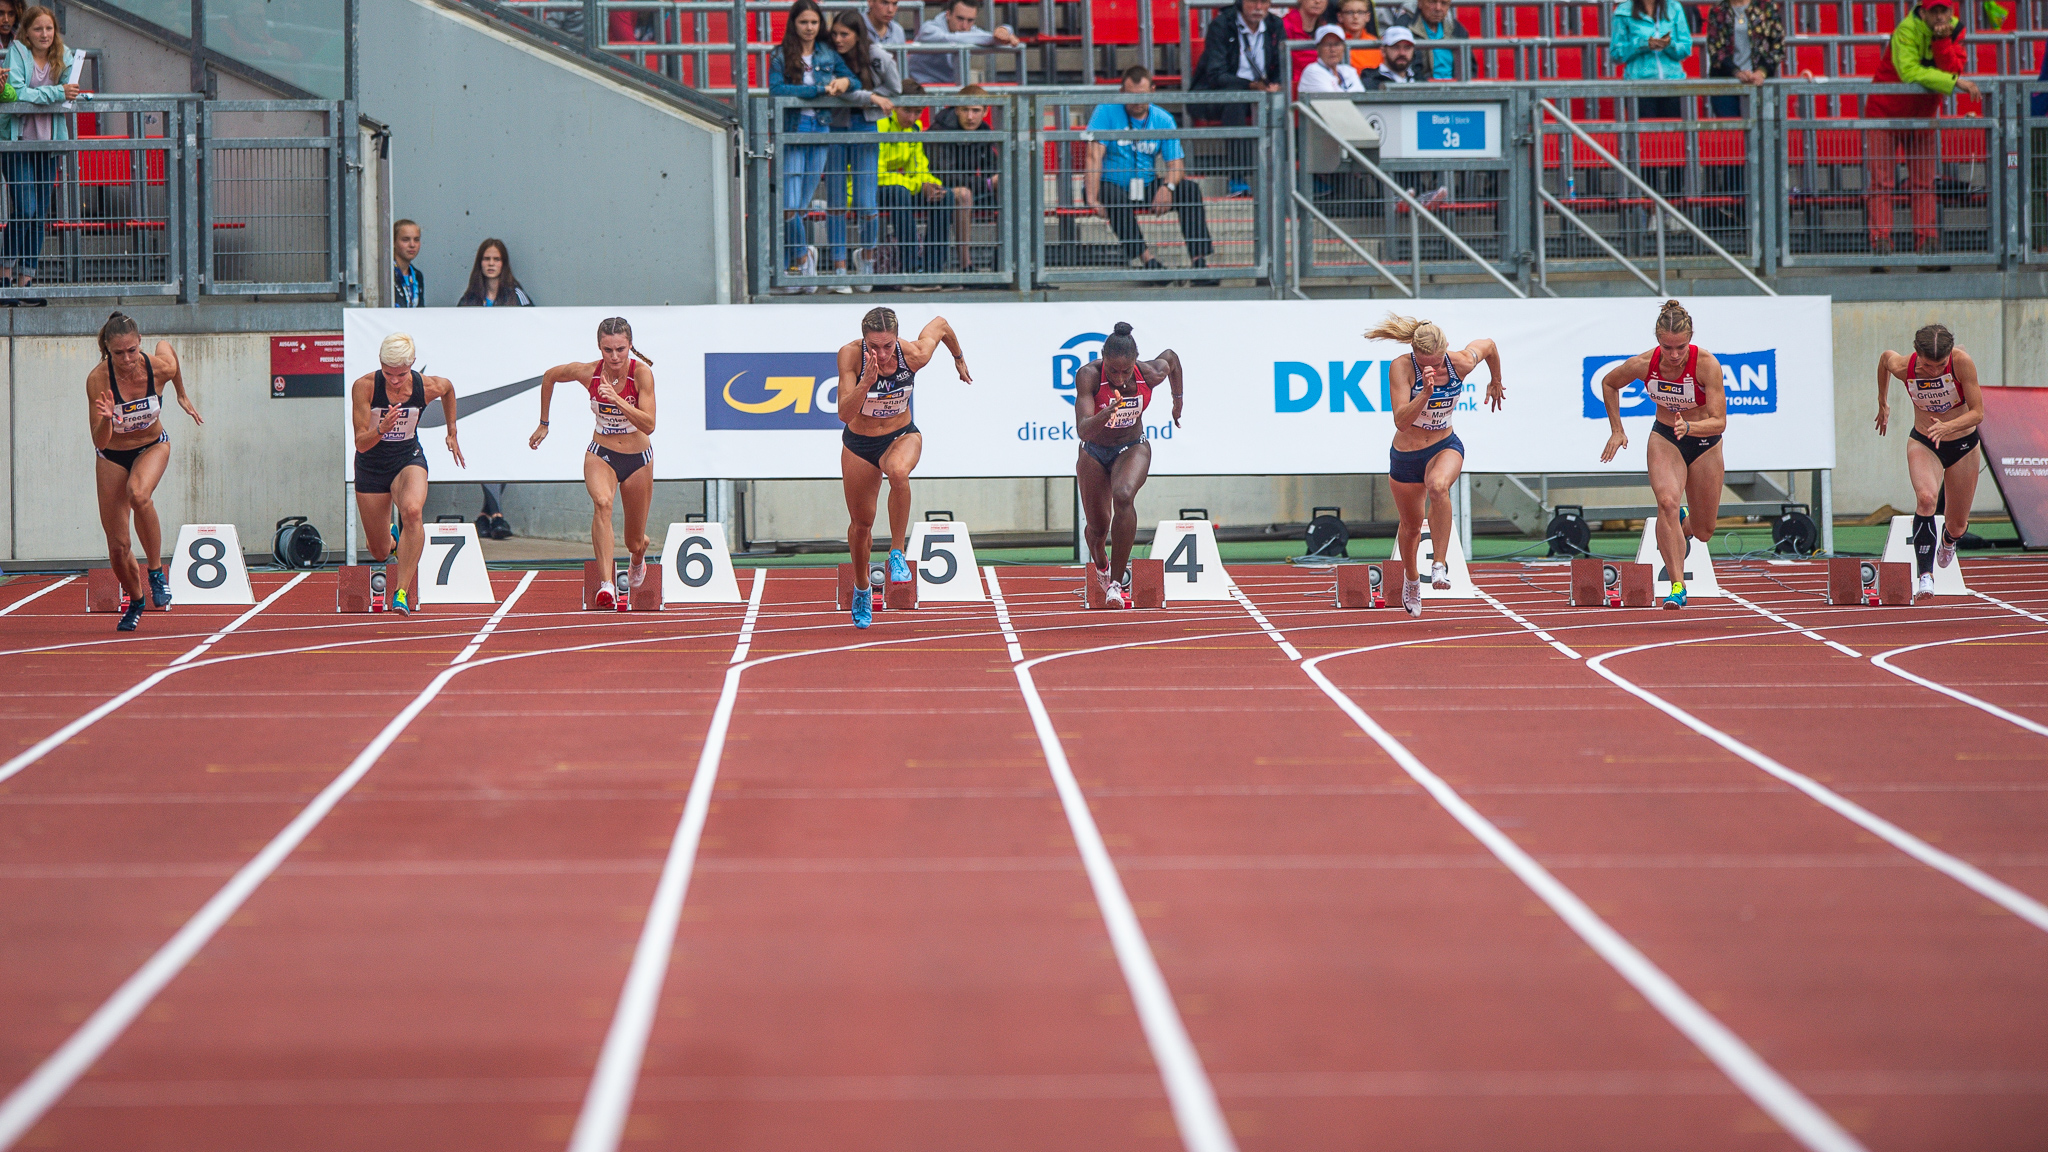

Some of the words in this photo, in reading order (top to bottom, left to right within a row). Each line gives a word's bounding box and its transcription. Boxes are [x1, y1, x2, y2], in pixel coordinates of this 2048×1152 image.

[1442, 127, 1460, 147] 3a
[1650, 392, 1693, 404] Bechthold
[1916, 389, 1950, 400] Grünert
[136, 401, 148, 410] GLS
[1126, 400, 1137, 408] GLS
[122, 413, 152, 423] Freese
[1115, 409, 1140, 418] wayie
[187, 536, 228, 589] 8
[430, 535, 466, 585] 7
[676, 535, 713, 588] 6
[918, 534, 958, 585] 5
[1164, 533, 1204, 583] 4
